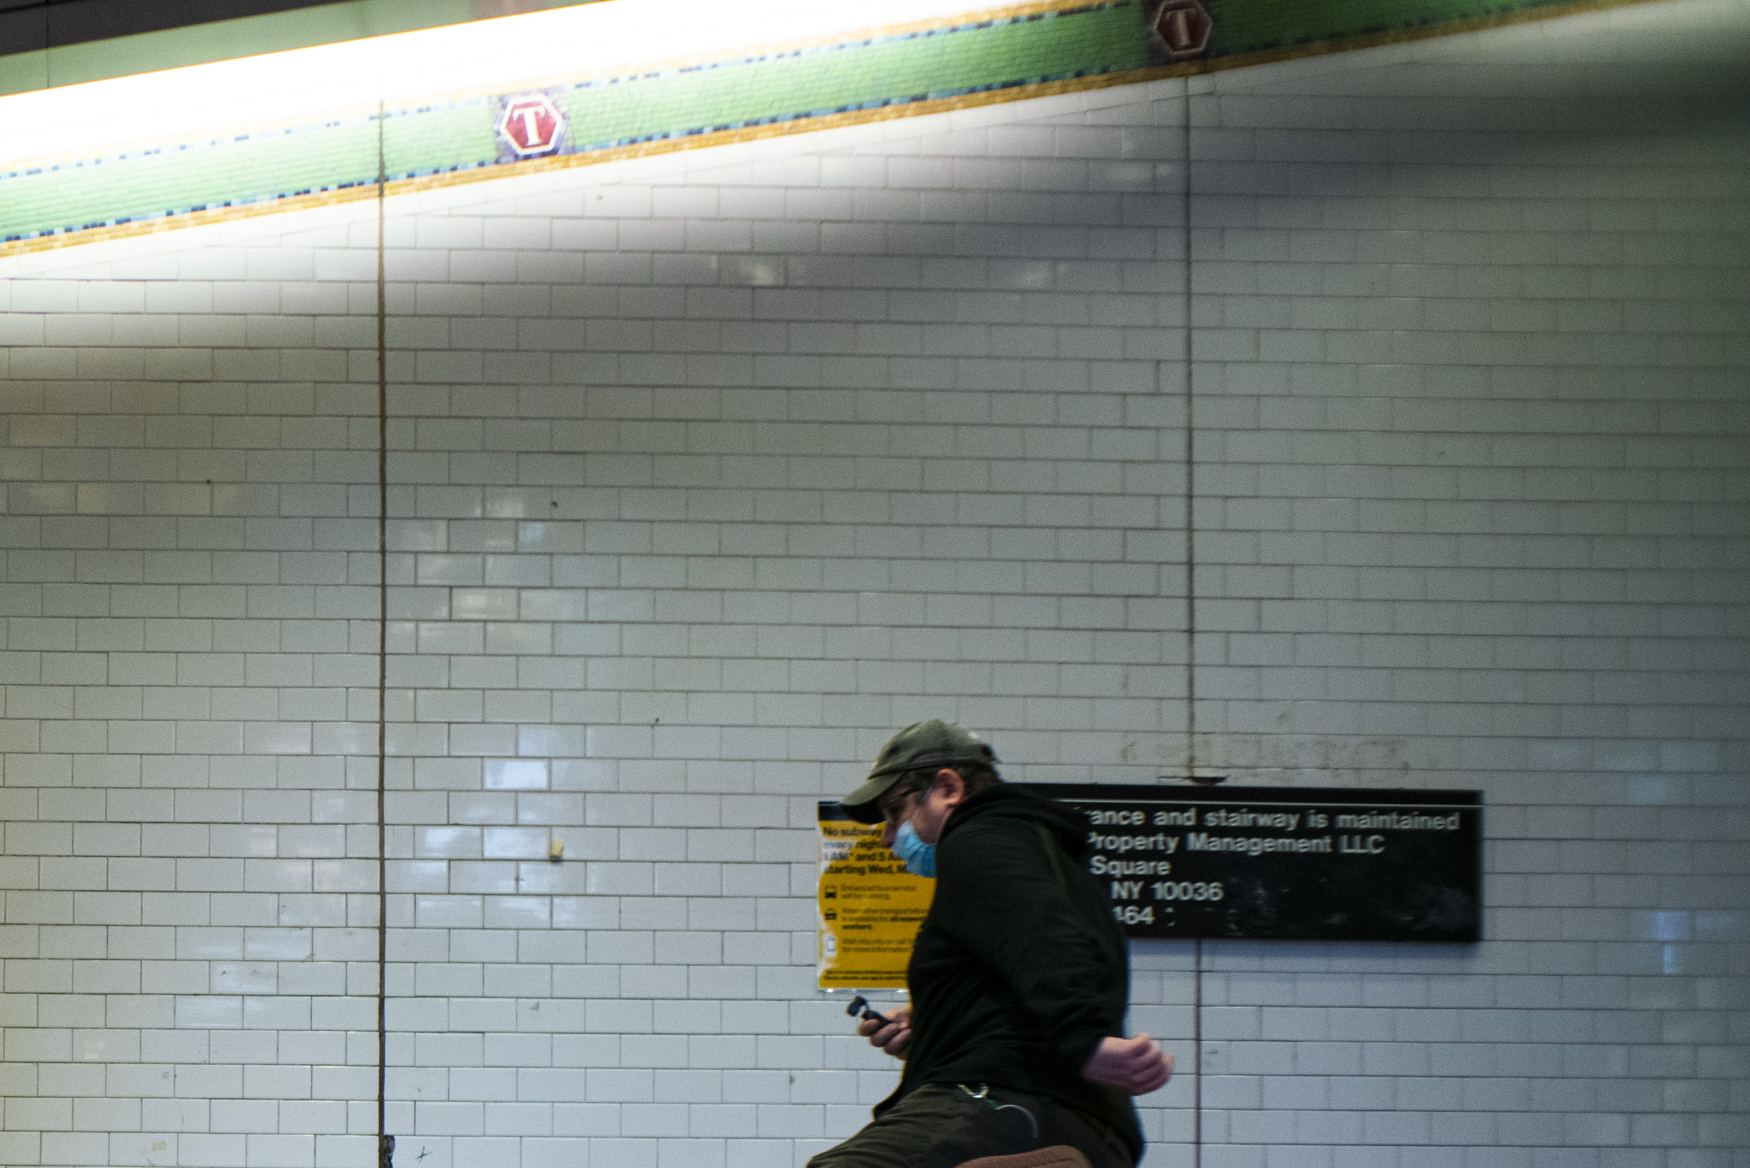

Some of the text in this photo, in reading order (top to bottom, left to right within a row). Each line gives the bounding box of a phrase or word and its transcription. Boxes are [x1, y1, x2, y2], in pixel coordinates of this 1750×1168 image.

[513, 105, 546, 147] T
[1084, 807, 1460, 832] ance and stairway is maintained
[855, 851, 877, 861] and
[1186, 832, 1333, 857] Management
[1339, 835, 1385, 855] LLC
[1089, 855, 1172, 878] Square
[1110, 880, 1225, 901] NY 10036
